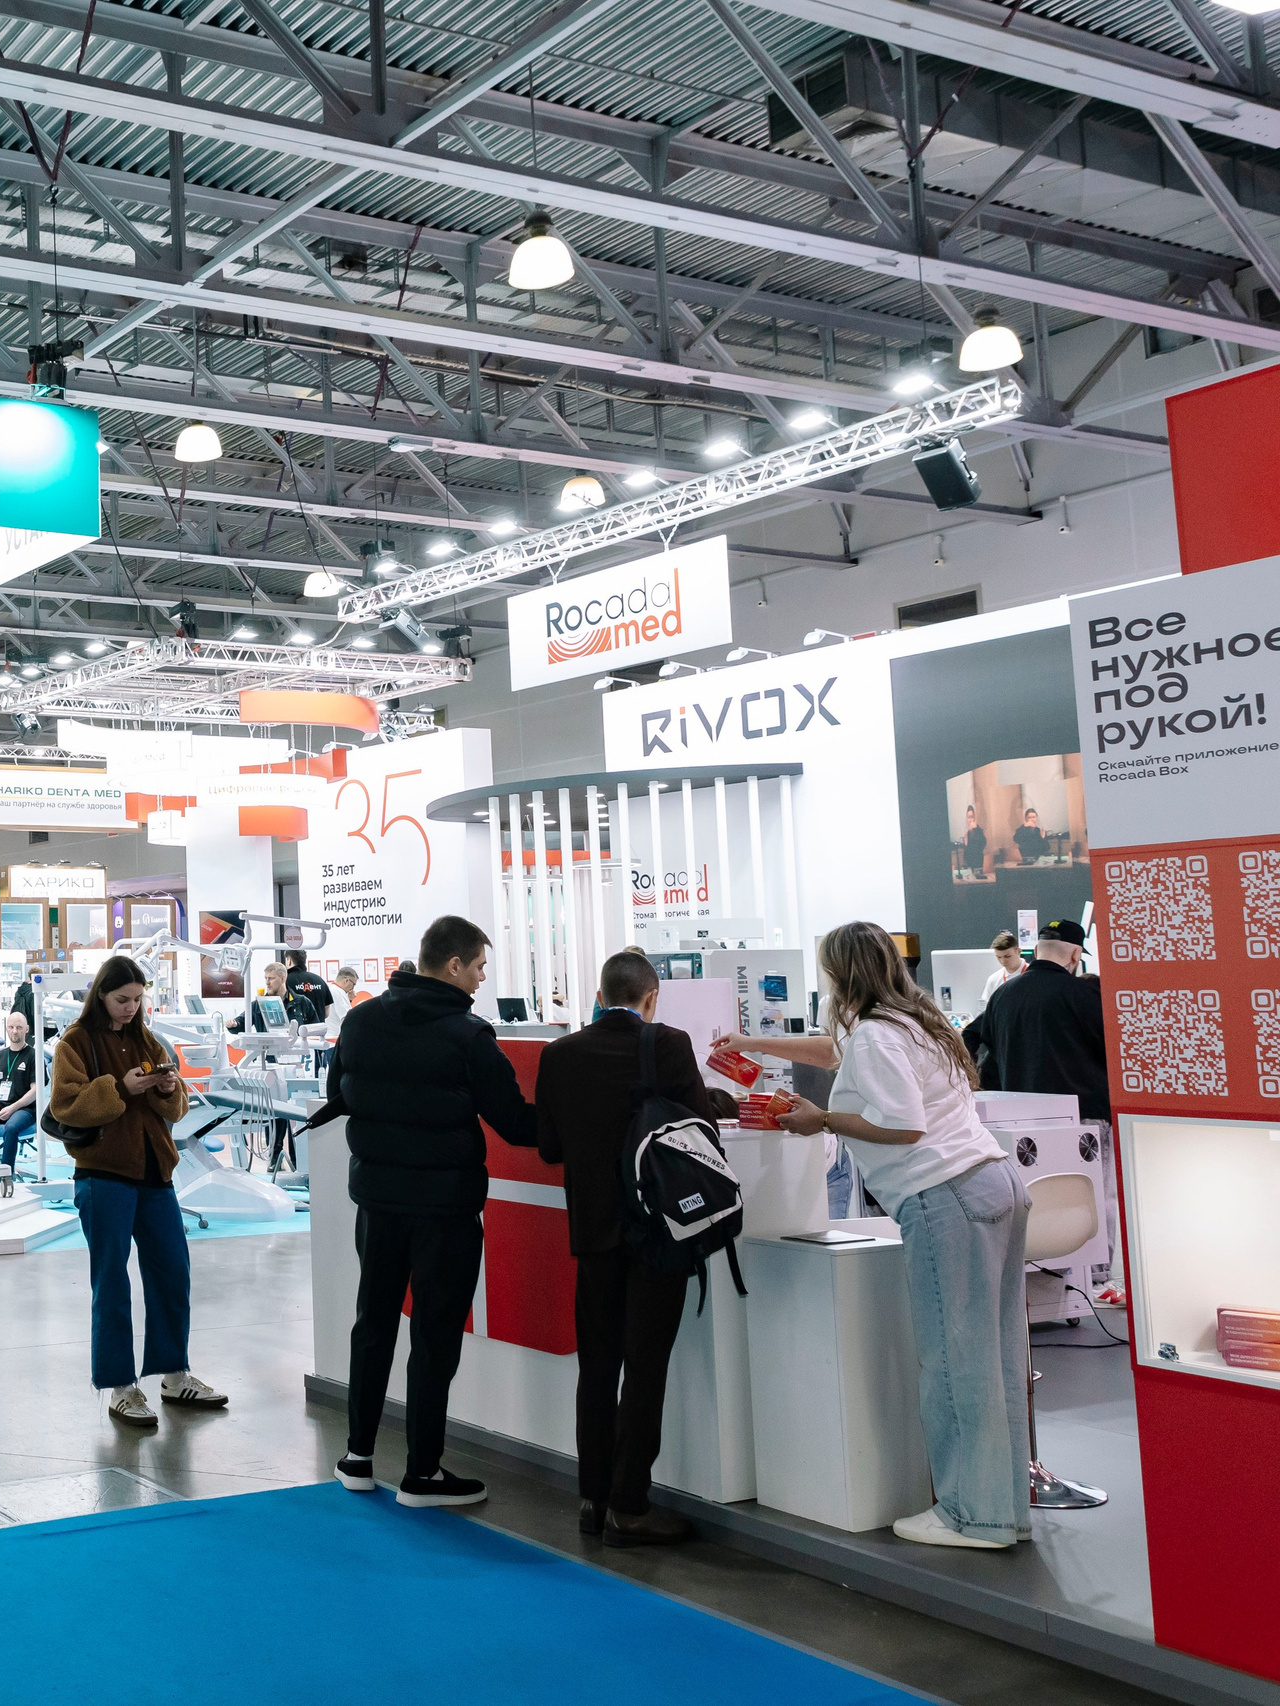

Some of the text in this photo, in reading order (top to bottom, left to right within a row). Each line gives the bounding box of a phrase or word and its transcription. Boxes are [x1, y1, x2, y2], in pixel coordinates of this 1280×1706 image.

[546, 576, 671, 638] Rocada
[615, 567, 682, 649] med
[1088, 612, 1187, 650] Все
[1091, 627, 1280, 685] нужное
[1094, 671, 1189, 714] под
[1097, 692, 1267, 754] рукой!
[1098, 741, 1280, 771] Скачайте приложение
[1099, 765, 1190, 783] Rocada Box
[12, 800, 45, 810] партнёр
[57, 801, 85, 811] службе
[86, 803, 123, 812] здоровья
[47, 787, 90, 797] DENTA
[94, 789, 122, 798] MED
[335, 768, 431, 886] 35
[23, 877, 94, 888] ХАРИКО
[322, 864, 355, 878] 35 лет
[323, 879, 383, 897] развиваем
[323, 896, 387, 913] индустрию
[736, 965, 749, 993] Mill
[667, 1136, 688, 1150] QUICK
